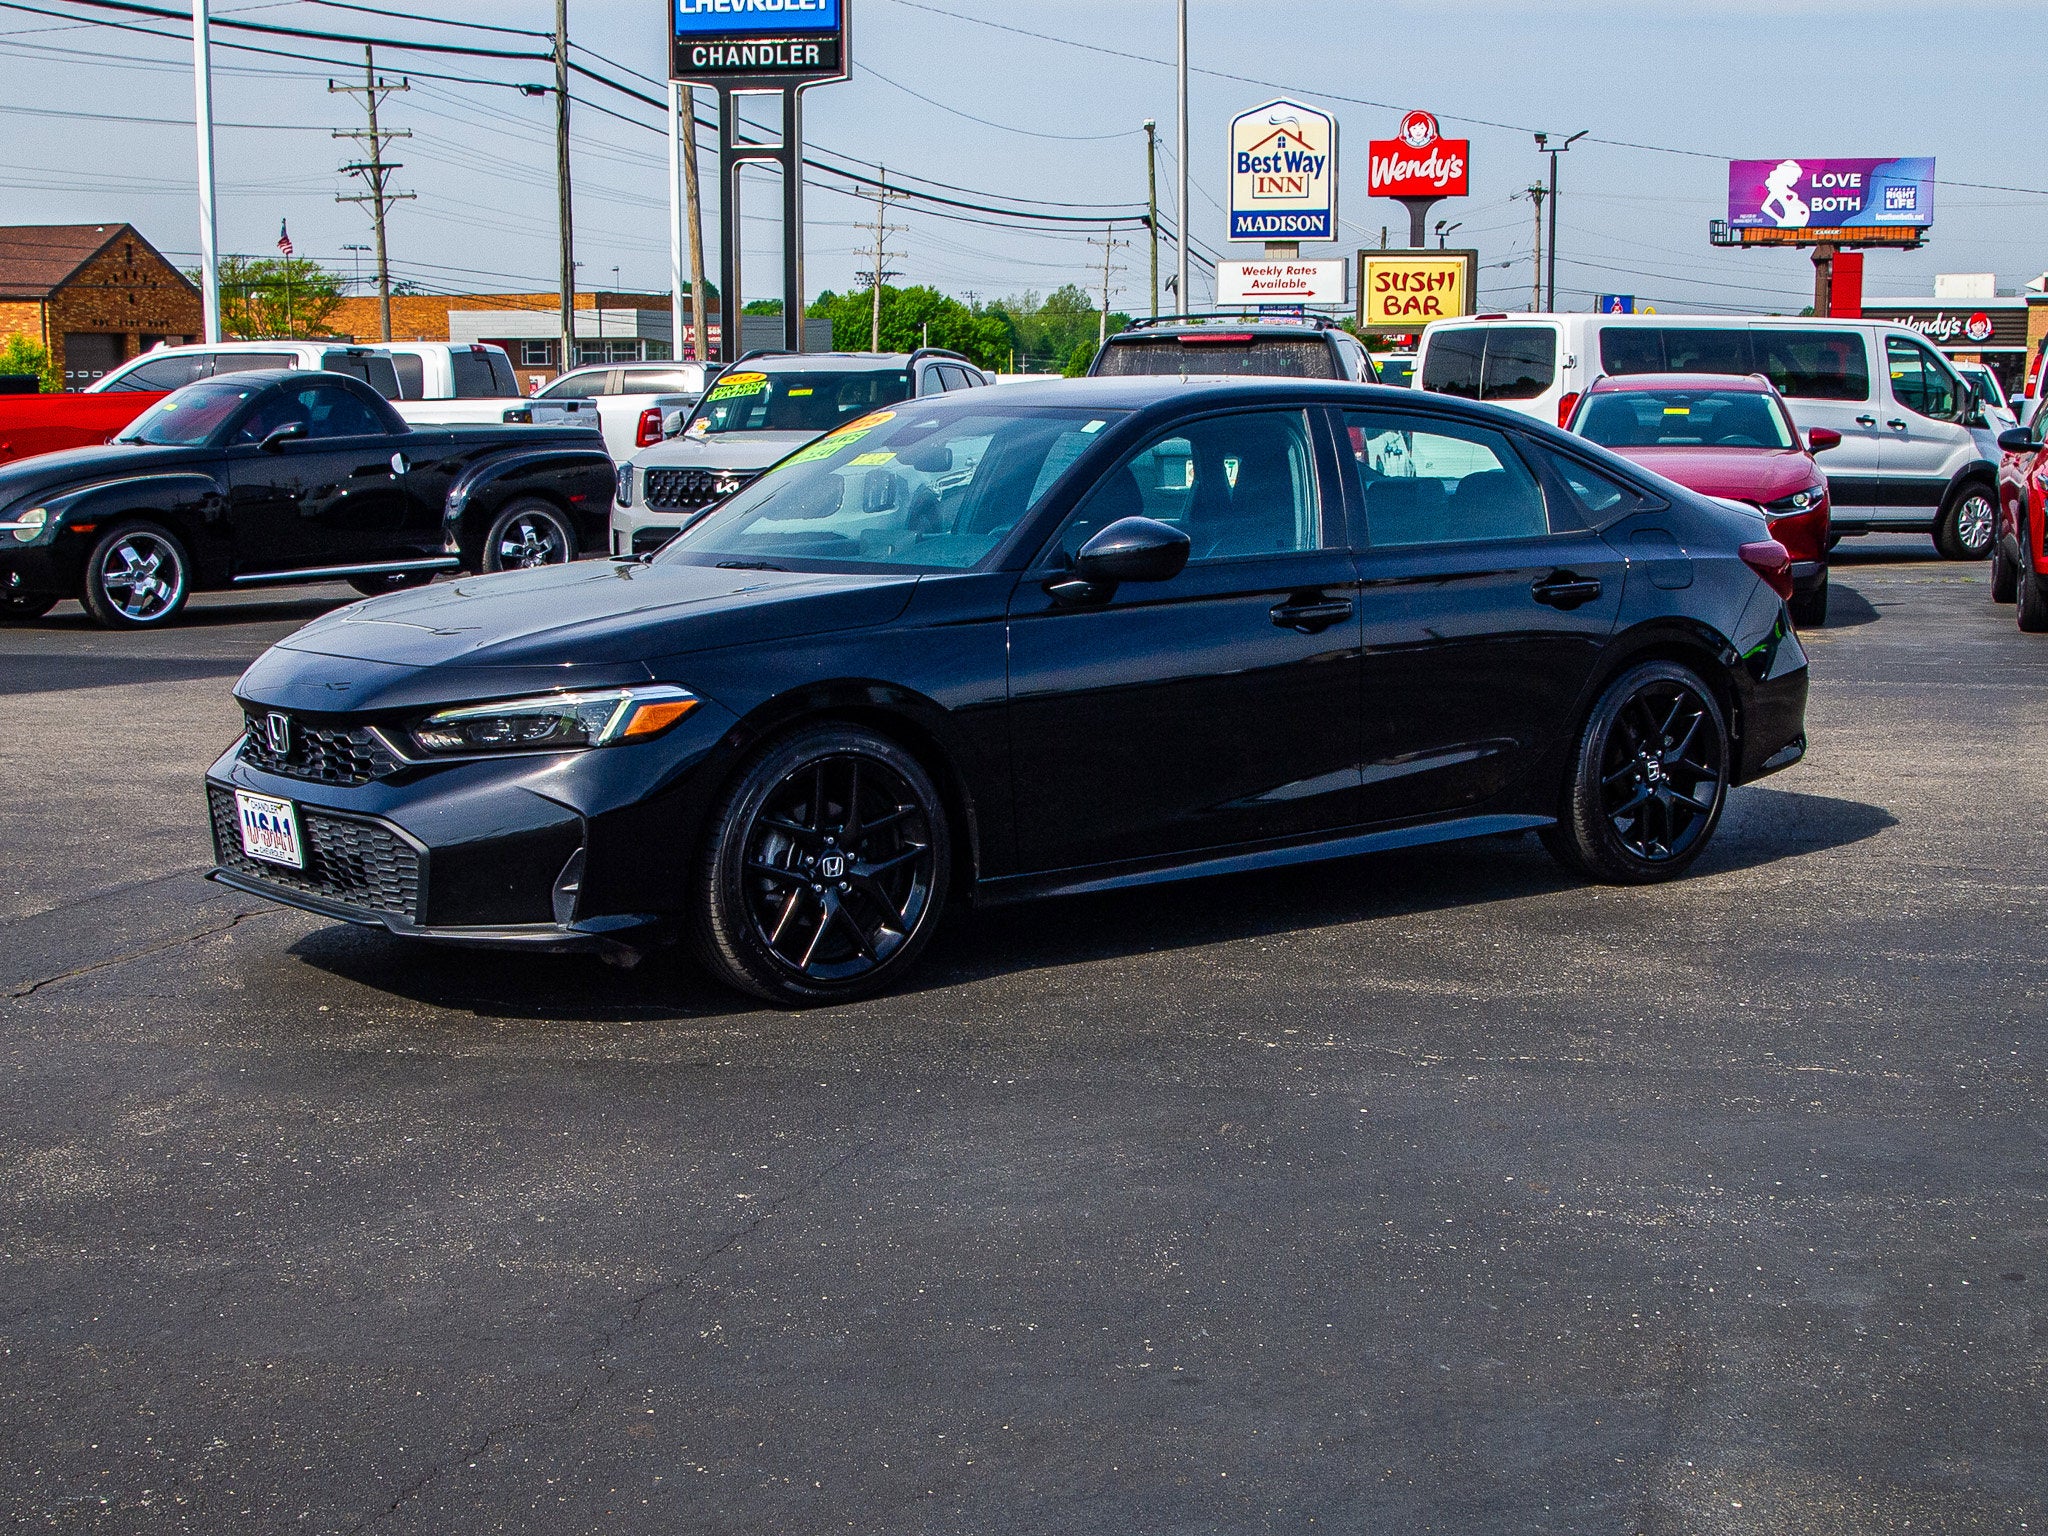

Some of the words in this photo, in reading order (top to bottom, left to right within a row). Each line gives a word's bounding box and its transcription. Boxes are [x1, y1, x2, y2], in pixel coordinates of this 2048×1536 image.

[692, 46, 819, 66] CHANDLER
[1237, 151, 1281, 173] Best
[1284, 151, 1326, 179] Way
[1371, 147, 1463, 189] Wendy's
[1258, 176, 1304, 193] INN
[1811, 173, 1861, 188] LOVE
[1832, 187, 1860, 196] them
[1811, 196, 1861, 212] BOTH
[1886, 199, 1915, 209] LIFE
[1236, 215, 1325, 232] MADISON
[1242, 266, 1283, 278] Weekly
[1286, 266, 1317, 275] Rates
[1251, 279, 1307, 289] Available
[1375, 271, 1455, 292] SUSHI
[1383, 295, 1444, 316] BAR
